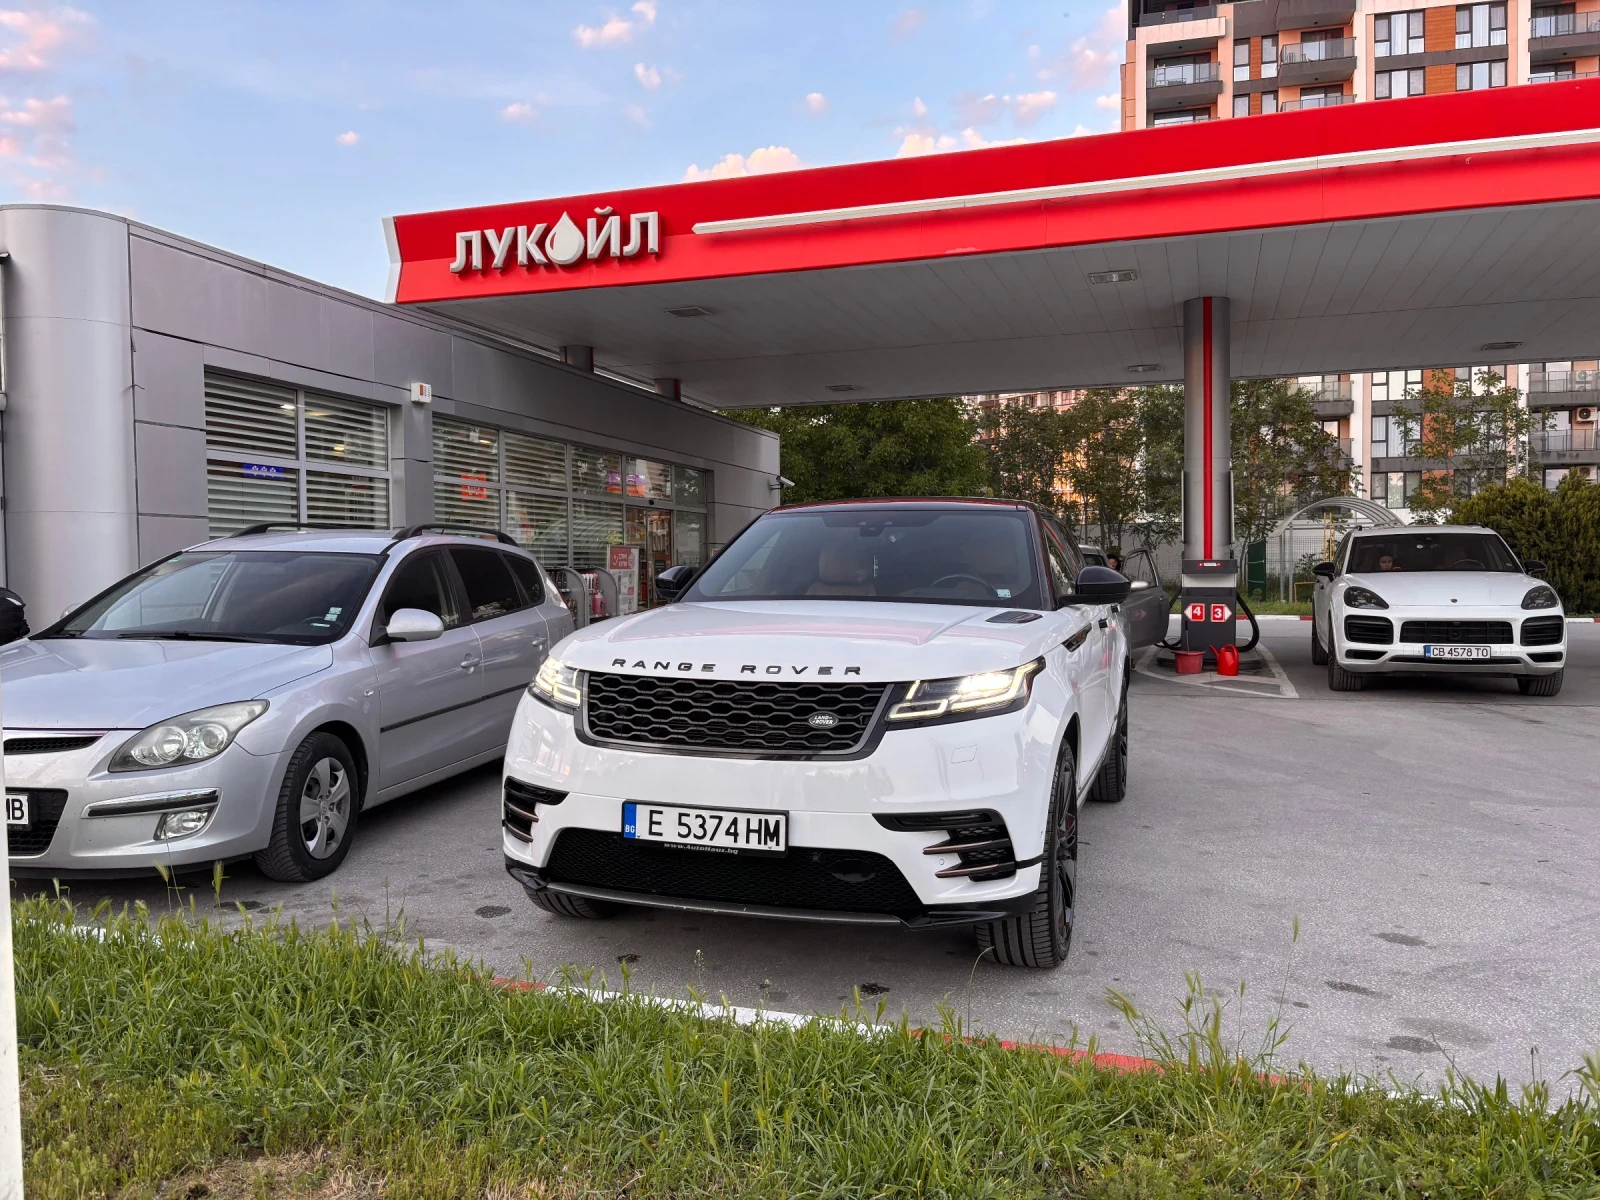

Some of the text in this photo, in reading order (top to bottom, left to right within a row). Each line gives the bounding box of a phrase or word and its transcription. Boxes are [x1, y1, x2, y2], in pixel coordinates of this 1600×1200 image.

[1193, 606, 1202, 616] 4
[1214, 608, 1223, 618] 3
[1432, 647, 1446, 657] CB
[1447, 647, 1473, 658] 4578
[1474, 647, 1489, 658] TO
[611, 657, 862, 676] RANGE ROVER
[648, 809, 664, 837] E
[624, 824, 636, 834] BG
